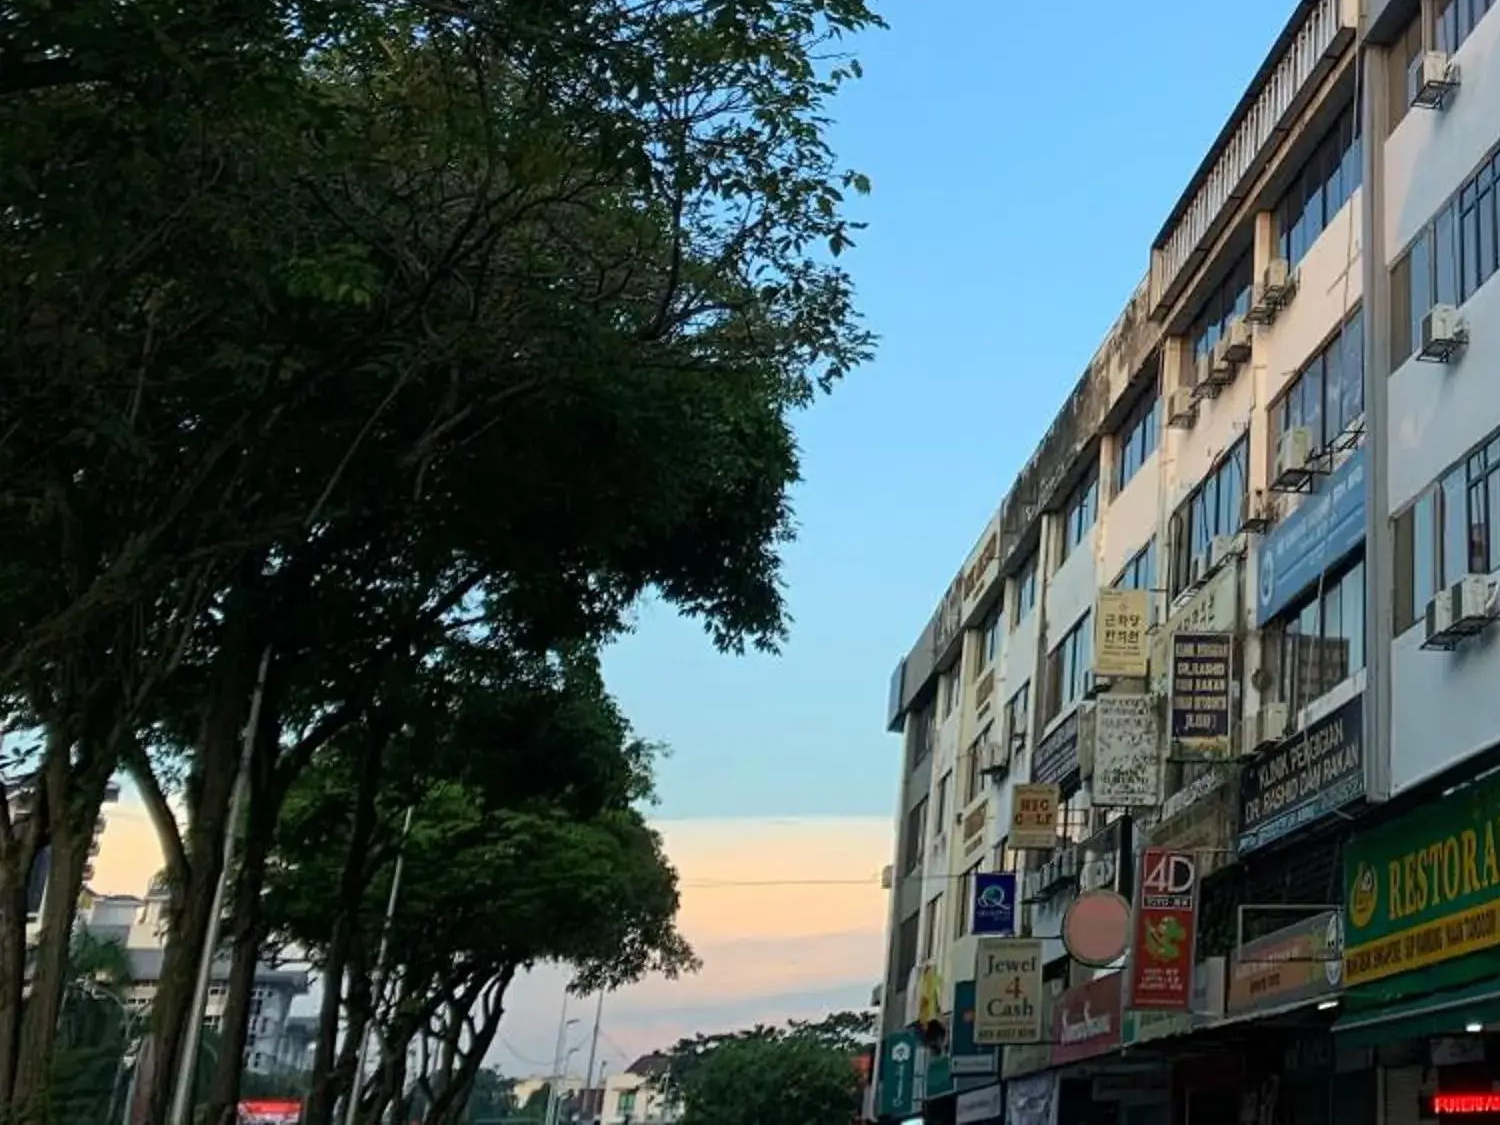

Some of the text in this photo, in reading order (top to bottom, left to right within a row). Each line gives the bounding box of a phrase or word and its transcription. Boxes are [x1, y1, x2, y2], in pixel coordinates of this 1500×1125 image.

[1143, 855, 1195, 894] 4D
[984, 954, 1036, 976] Jewel
[1005, 976, 1024, 999] 4
[986, 997, 1034, 1018] Cash
